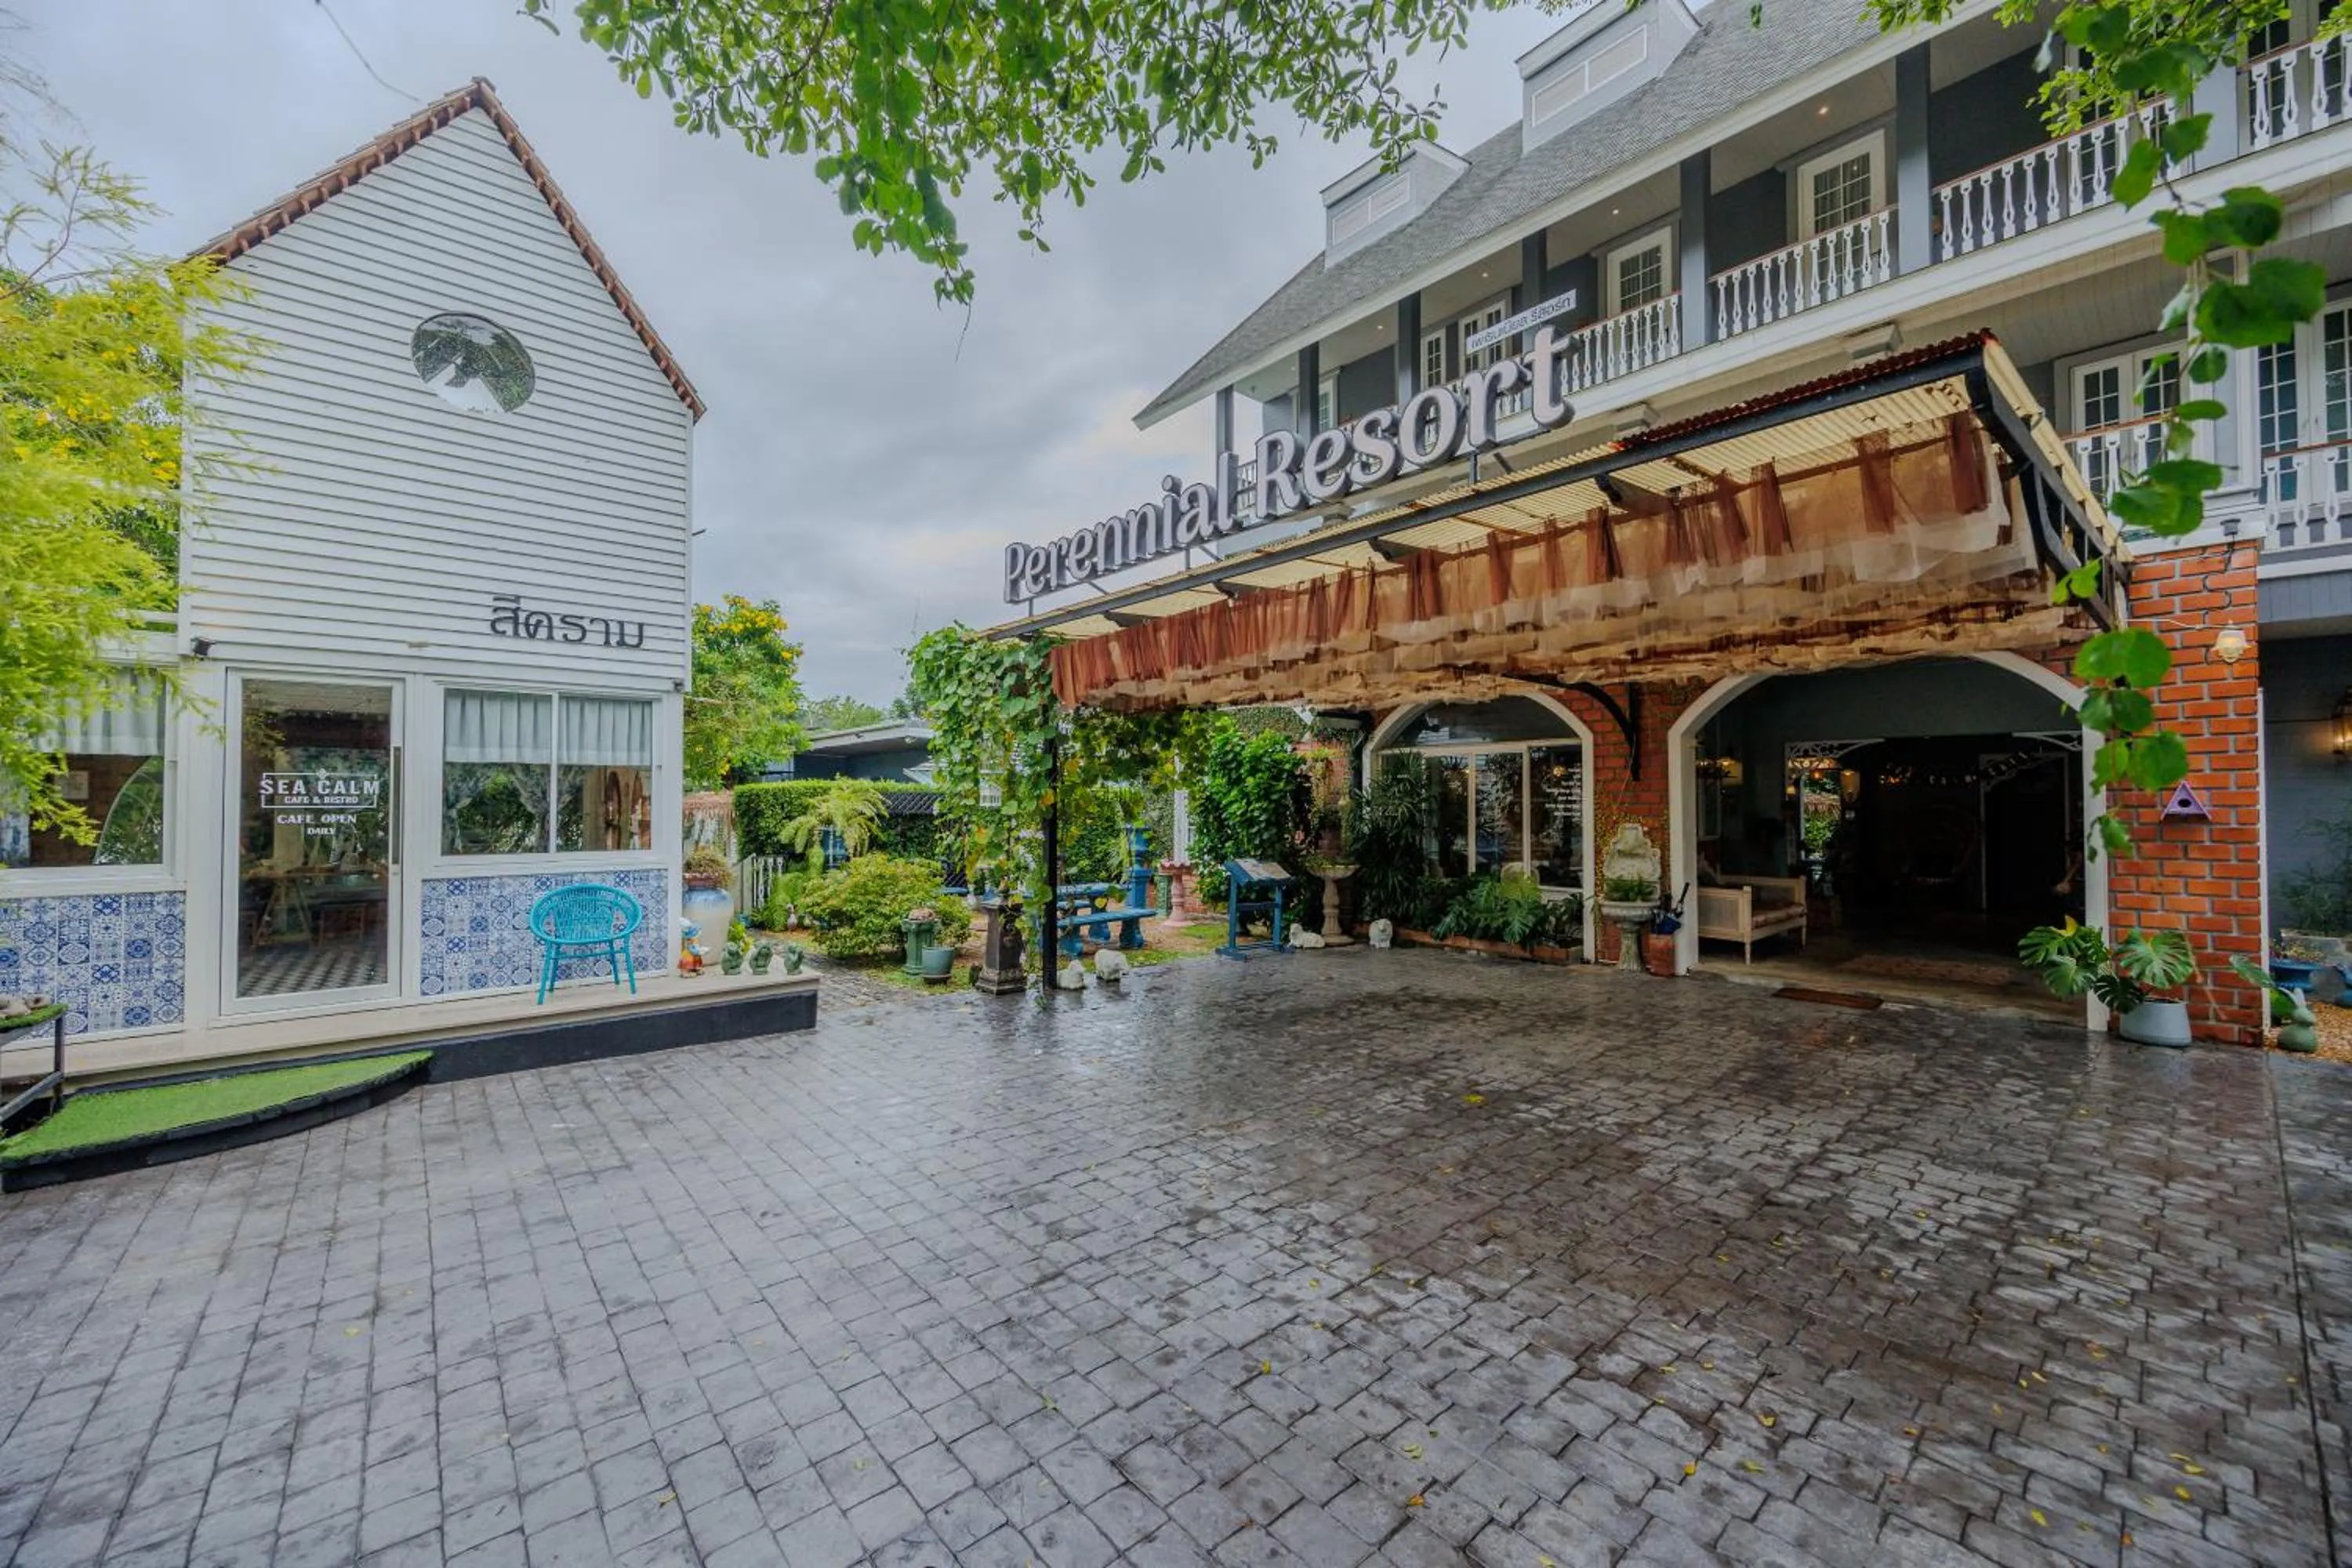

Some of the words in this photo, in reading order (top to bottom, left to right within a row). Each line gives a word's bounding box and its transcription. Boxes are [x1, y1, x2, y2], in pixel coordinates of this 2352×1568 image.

[1004, 451, 1236, 603] Perennial
[1256, 324, 1577, 518] Resort
[490, 596, 644, 648] สีคราม
[260, 780, 307, 794] SEA
[318, 780, 379, 794] CALM
[276, 814, 315, 823] CAFE
[321, 814, 357, 823] OPEN
